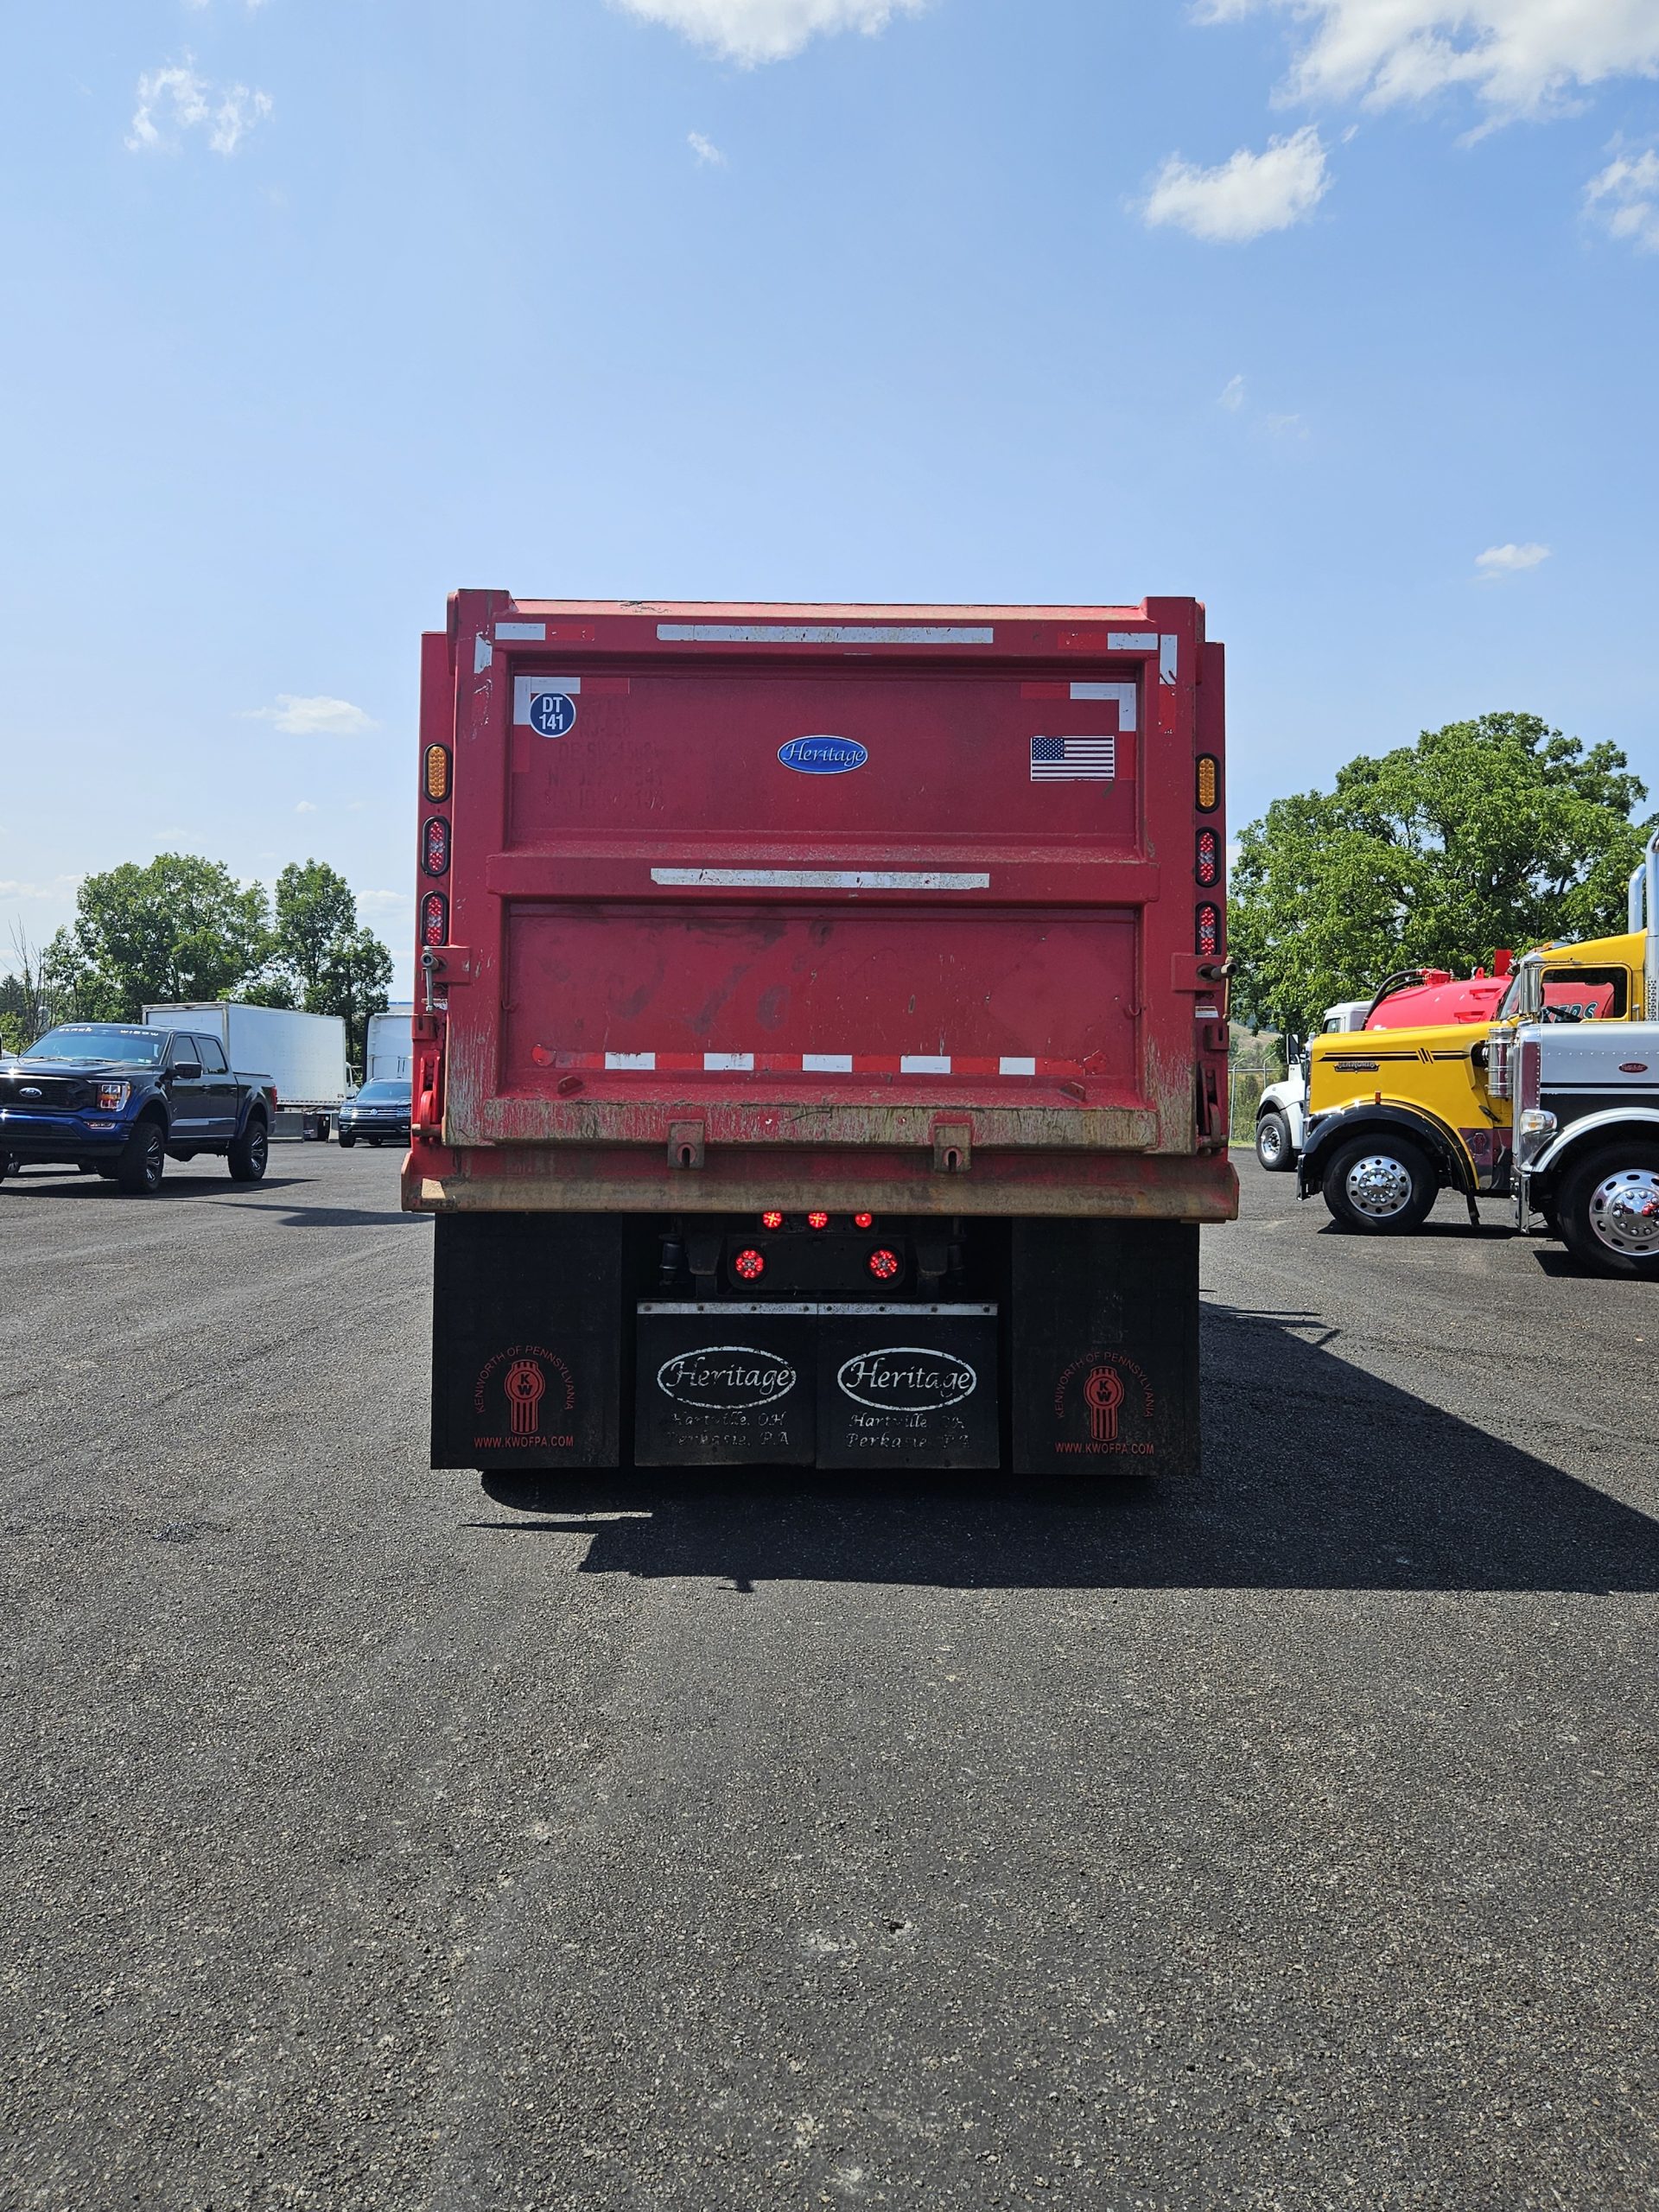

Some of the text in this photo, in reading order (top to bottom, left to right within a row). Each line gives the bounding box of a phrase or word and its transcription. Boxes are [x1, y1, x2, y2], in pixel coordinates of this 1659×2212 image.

[543, 696, 563, 713] DT
[539, 714, 563, 730] 141
[783, 741, 864, 767] Heritage
[474, 1344, 575, 1414] KENWORTH OF PENNSYLVANIA
[665, 1356, 790, 1395] Heritage
[845, 1357, 971, 1397] Heritage
[1053, 1351, 1155, 1419] KENWORTH OF PENNSYLVANIA
[474, 1435, 575, 1449] WWW.KWOFPA.COM
[1054, 1441, 1154, 1456] WWW.KWOFPA.COM
